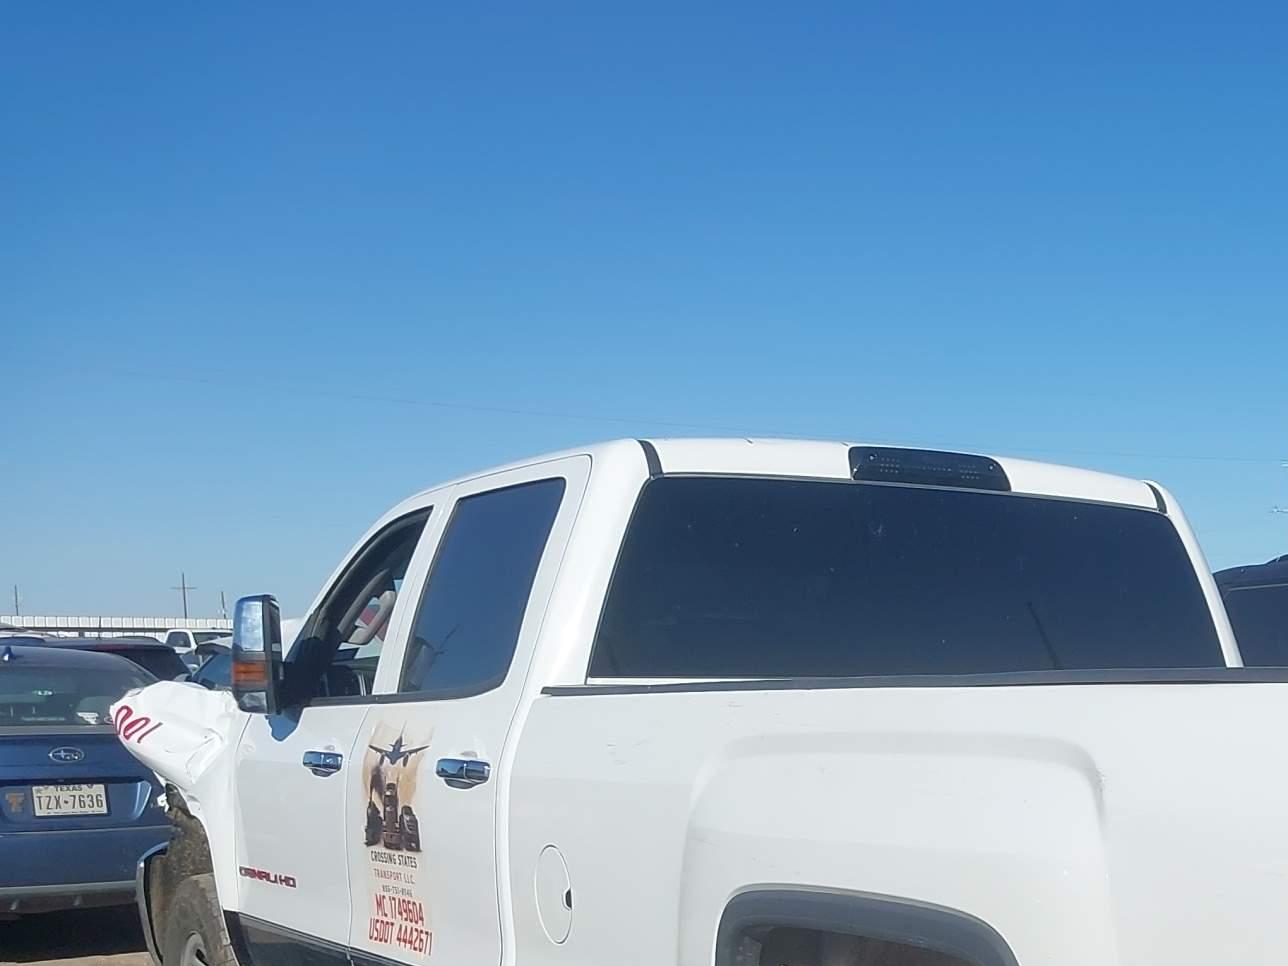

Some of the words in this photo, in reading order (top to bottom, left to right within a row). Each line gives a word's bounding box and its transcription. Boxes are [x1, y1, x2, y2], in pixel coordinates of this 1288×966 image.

[36, 794, 104, 810] TZX-7636
[370, 850, 397, 865] CROSSING
[397, 854, 418, 869] STATES
[373, 867, 402, 882] TRANSPORT
[375, 893, 388, 918] MC
[388, 895, 425, 927] 1749604
[369, 917, 395, 945] USDOT
[396, 923, 433, 956] 4442671
